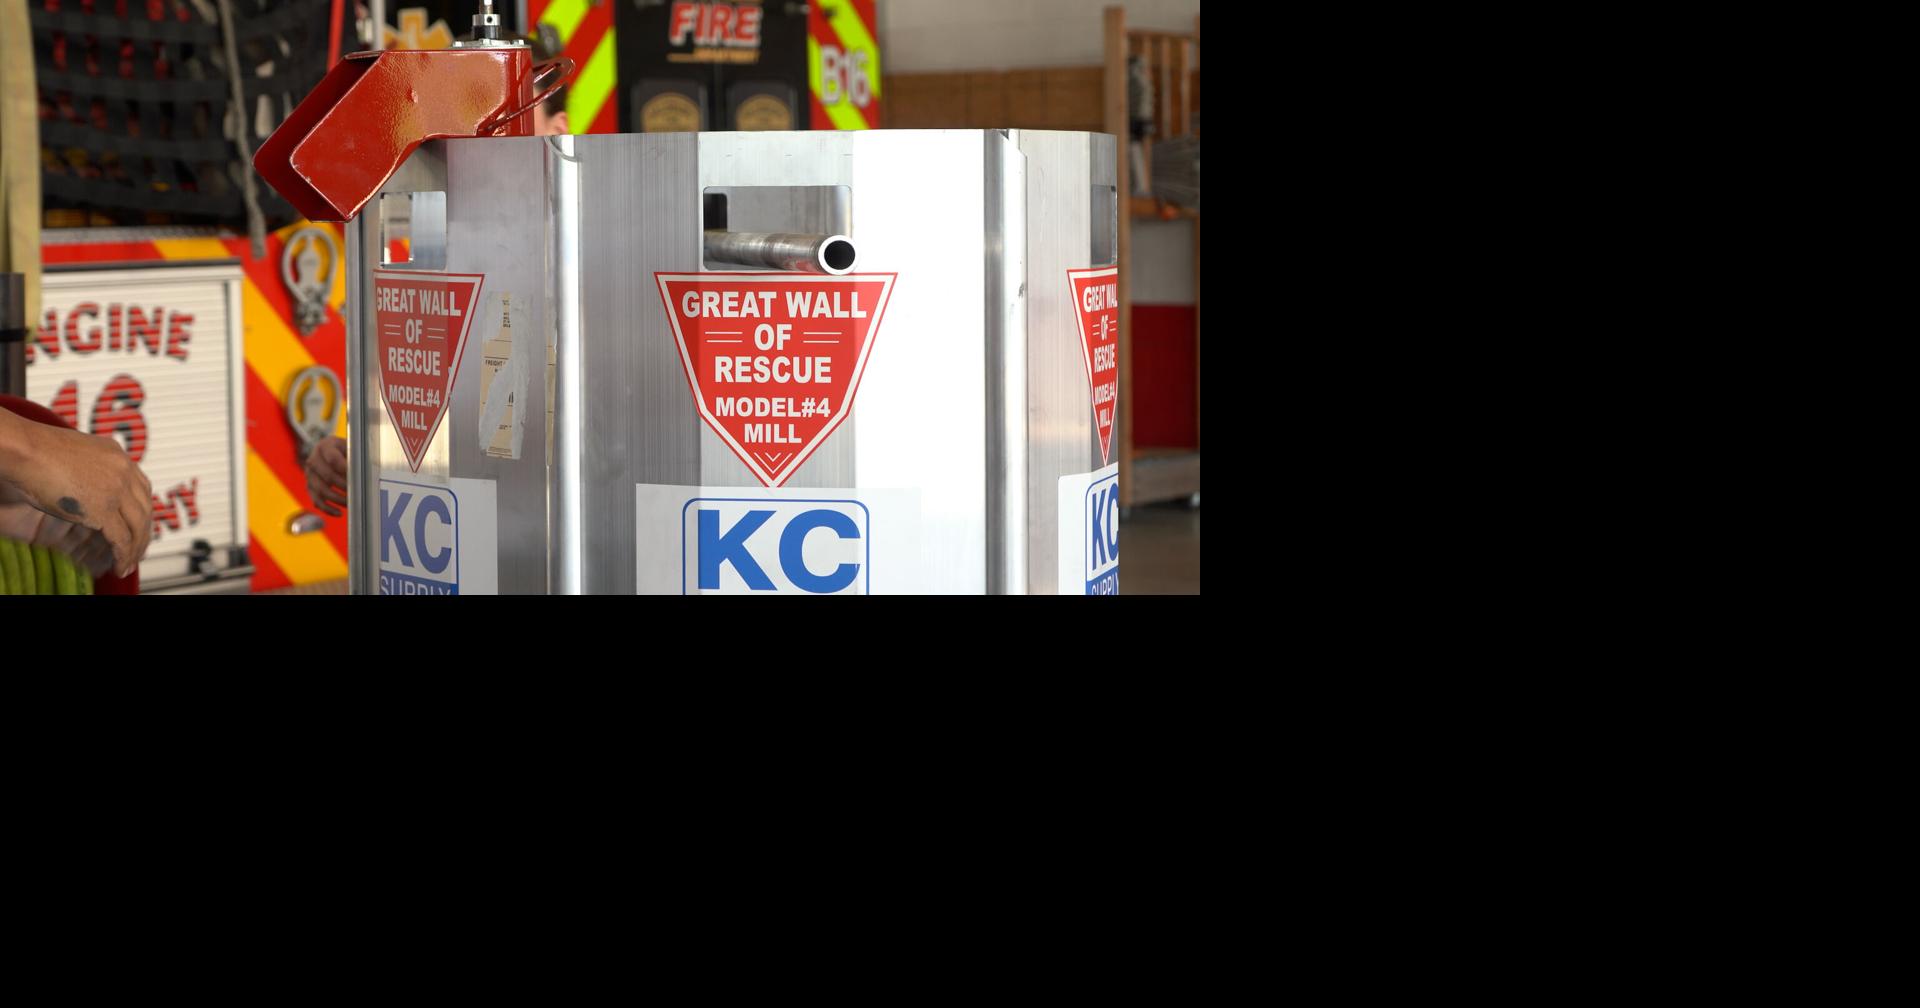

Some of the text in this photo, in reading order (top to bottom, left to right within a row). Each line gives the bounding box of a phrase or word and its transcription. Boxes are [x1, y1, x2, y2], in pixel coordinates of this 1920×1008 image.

[669, 1, 764, 48] FIRE
[820, 45, 870, 108] B16
[376, 286, 462, 317] GREAT WALL
[682, 290, 868, 319] GREAT WALL
[1083, 283, 1118, 313] GREAT WAL
[26, 301, 194, 365] NGINE
[405, 318, 423, 344] OF
[754, 323, 793, 351] OF
[1100, 314, 1109, 341] OF
[388, 346, 441, 377] RESCUE
[714, 355, 832, 384] RESCUE
[1094, 343, 1116, 374] RESCUE
[388, 384, 441, 409] MODEL#4
[714, 396, 831, 418] MODEL#4
[401, 409, 428, 431] MILL
[744, 423, 802, 444] MILL
[380, 489, 453, 575] KC
[1092, 483, 1119, 571] KC
[698, 508, 861, 594] KC
